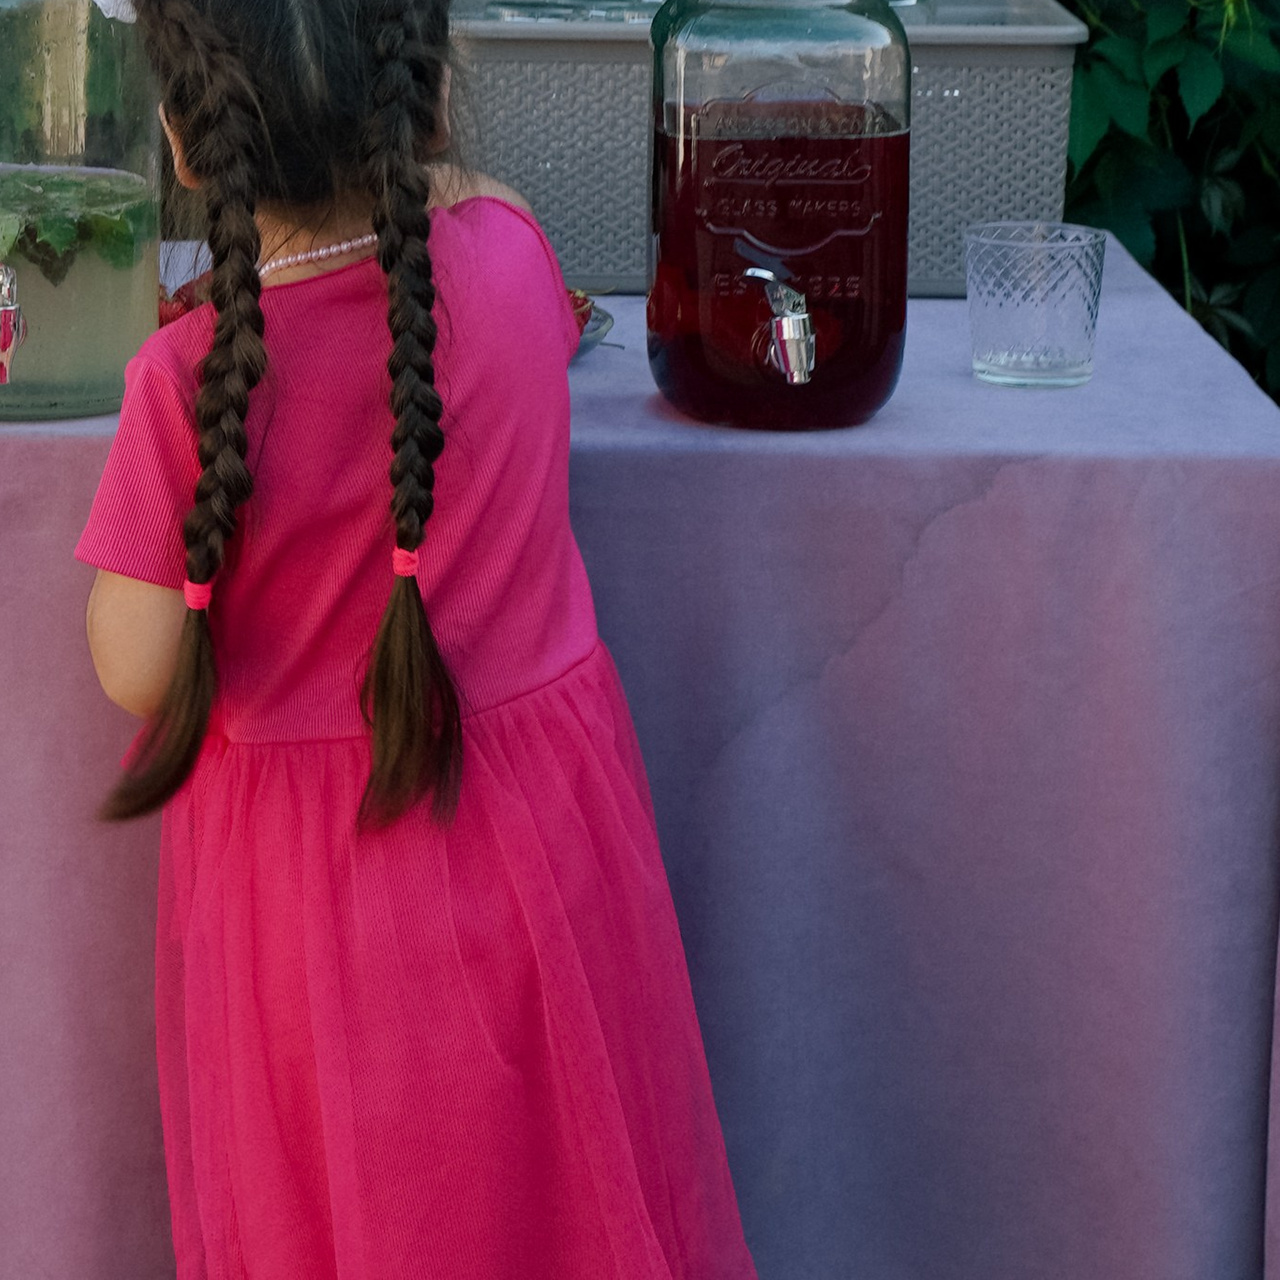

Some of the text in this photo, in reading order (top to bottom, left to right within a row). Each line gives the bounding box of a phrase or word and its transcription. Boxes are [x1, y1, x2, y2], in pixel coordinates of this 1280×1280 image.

[712, 143, 872, 188] Original
[717, 196, 861, 218] GLASS MAKERS
[712, 273, 748, 296] ES
